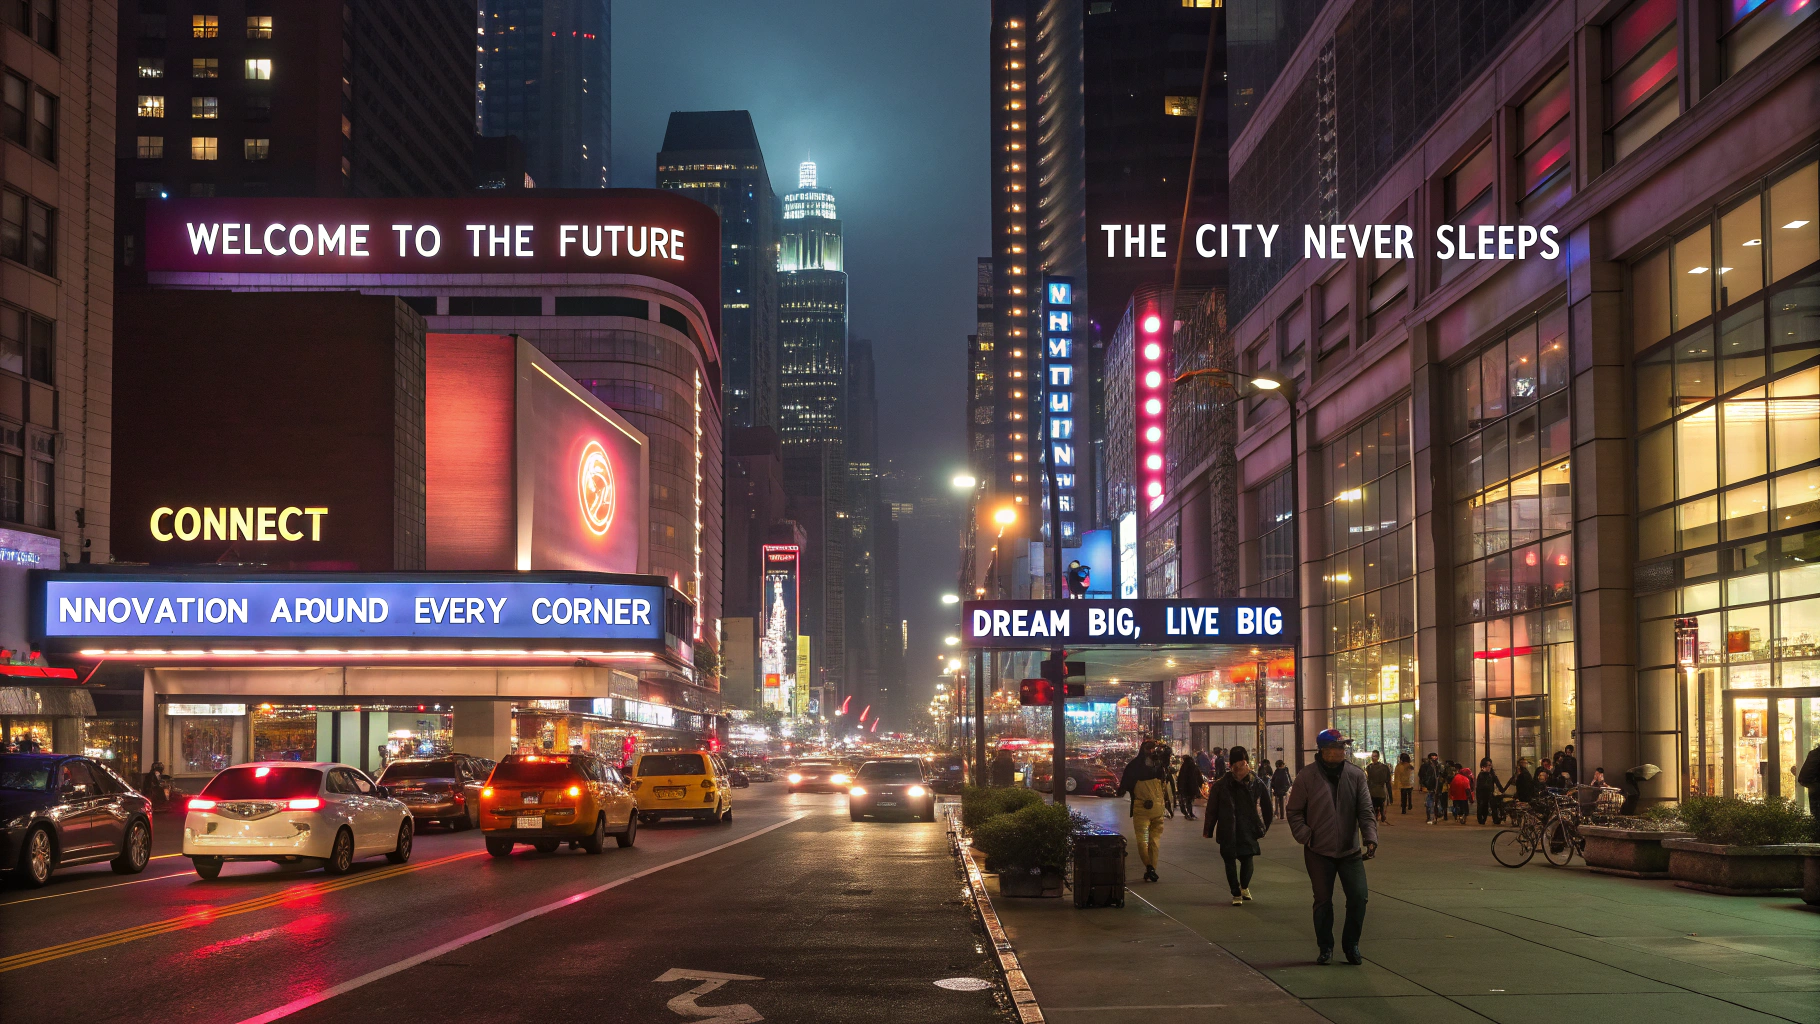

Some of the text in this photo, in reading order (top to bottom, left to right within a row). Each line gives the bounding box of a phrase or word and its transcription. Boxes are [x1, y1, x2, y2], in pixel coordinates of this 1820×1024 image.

[186, 222, 685, 261] WELCOME TO THE FUTURE
[150, 506, 329, 542] CONNECT
[59, 597, 248, 624] NNOVATION
[415, 597, 508, 624] EVERY
[531, 597, 651, 625] CORNER
[973, 606, 1282, 640] DREAM BIG, LIVE BIG
